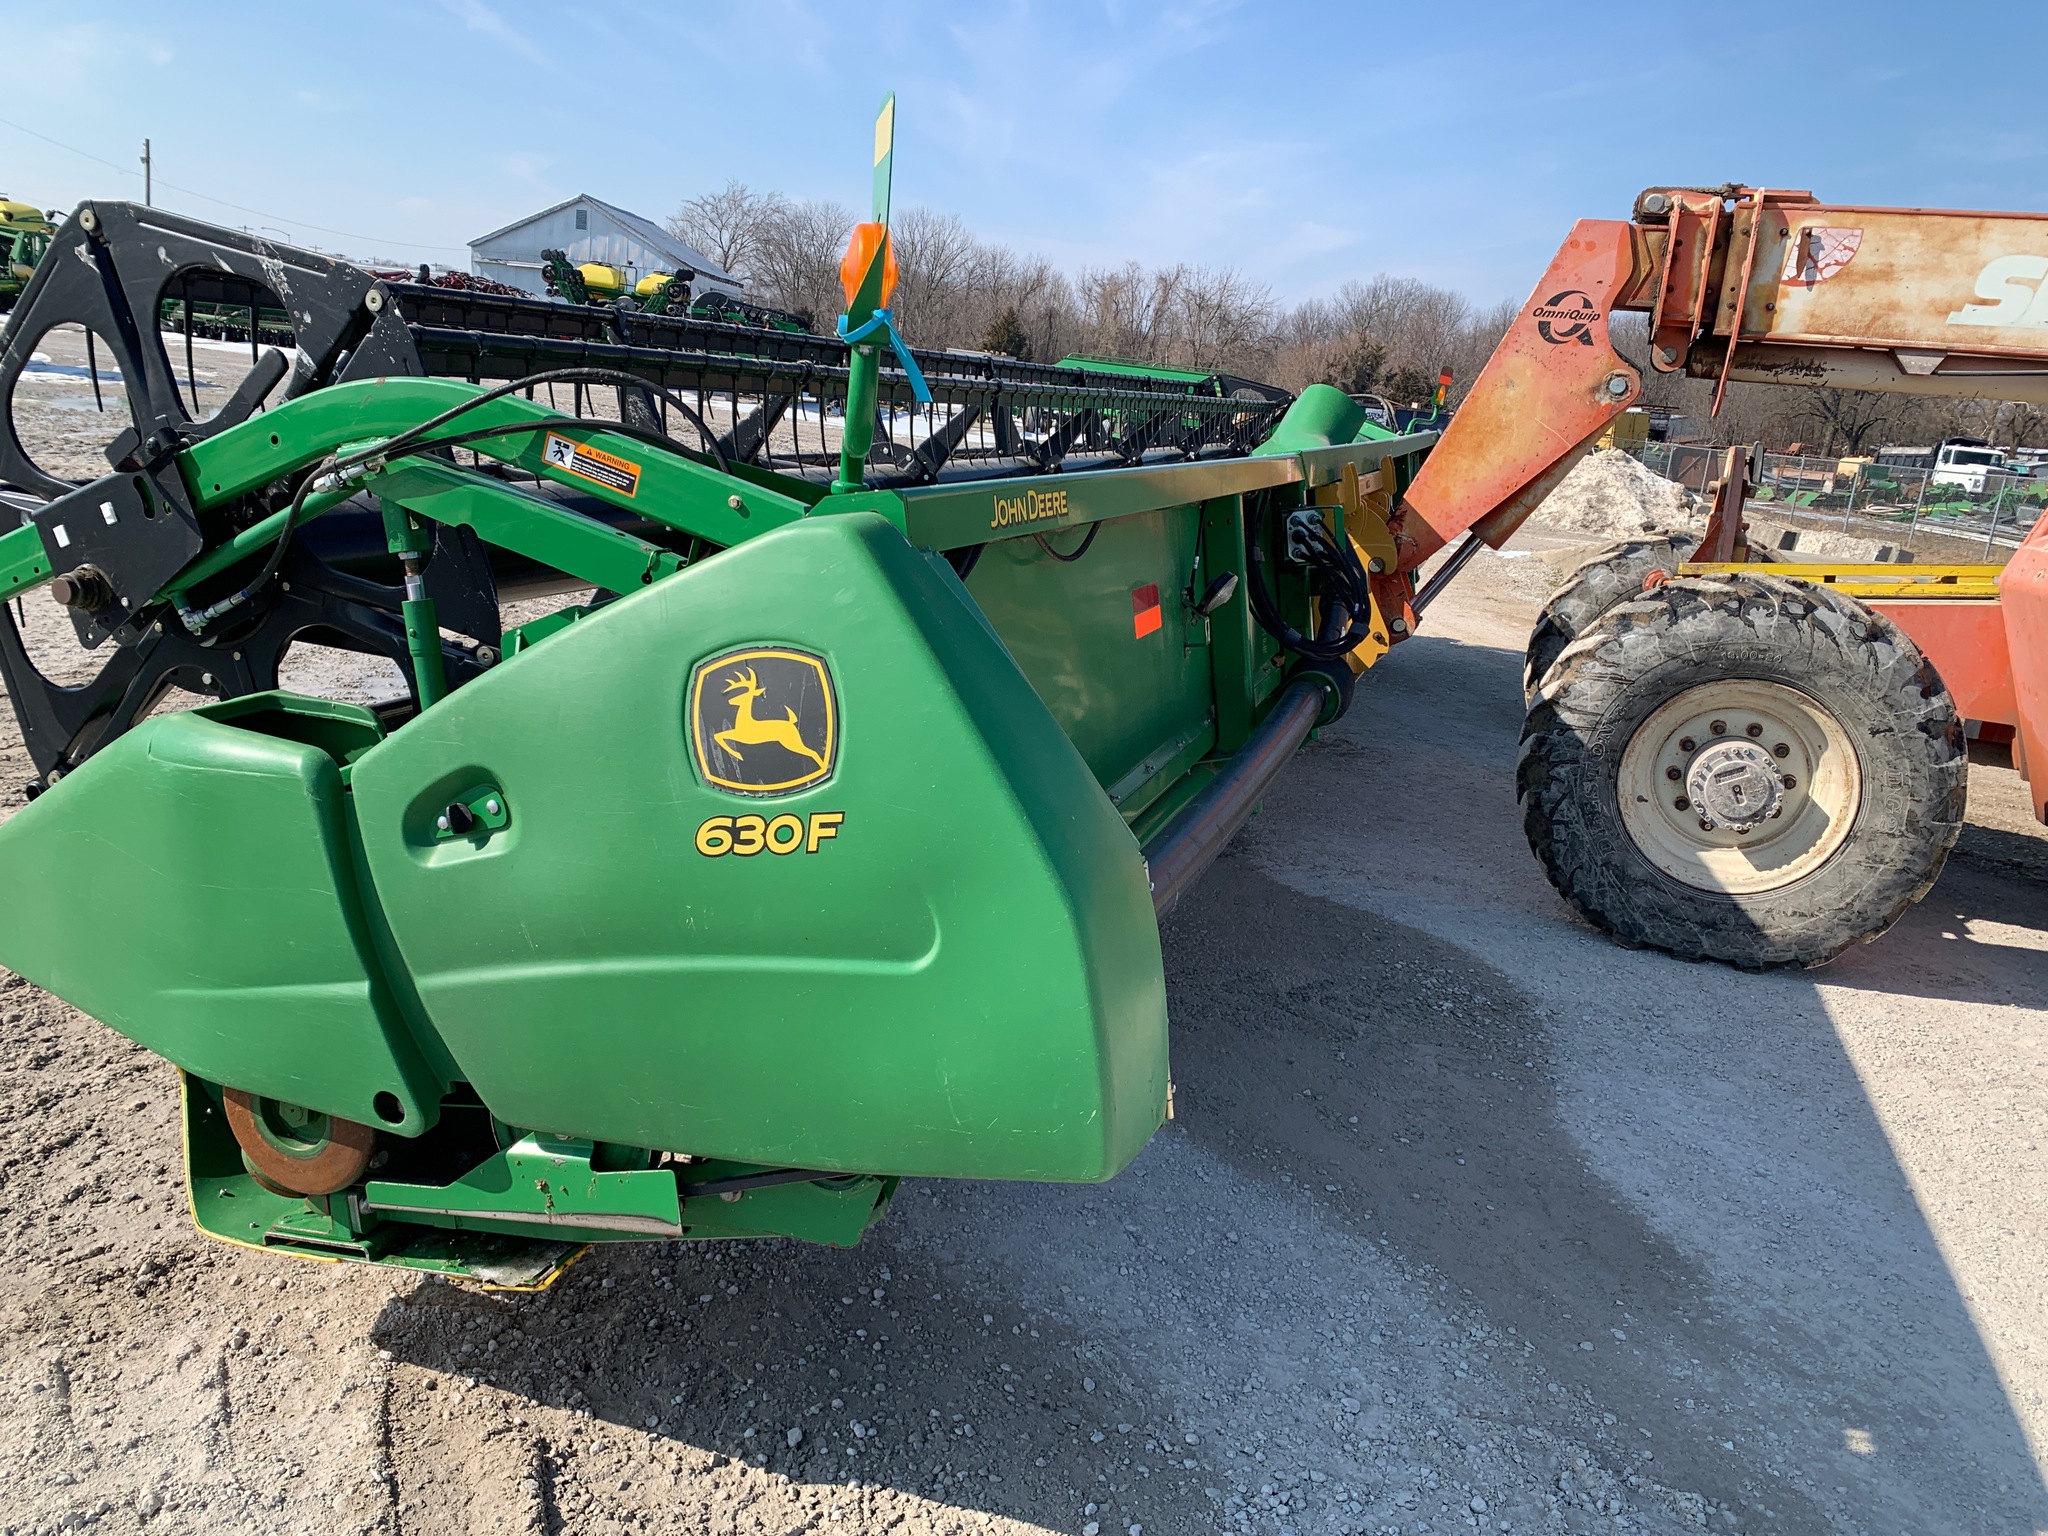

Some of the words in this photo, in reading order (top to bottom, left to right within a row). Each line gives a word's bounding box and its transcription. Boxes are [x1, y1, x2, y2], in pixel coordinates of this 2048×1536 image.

[1945, 254, 2048, 329] S
[1533, 307, 1601, 323] OmniQuip
[595, 450, 630, 470] WARNING
[990, 493, 1028, 529] JOHN
[1027, 489, 1069, 521] DEERE
[695, 811, 845, 858] 630F
